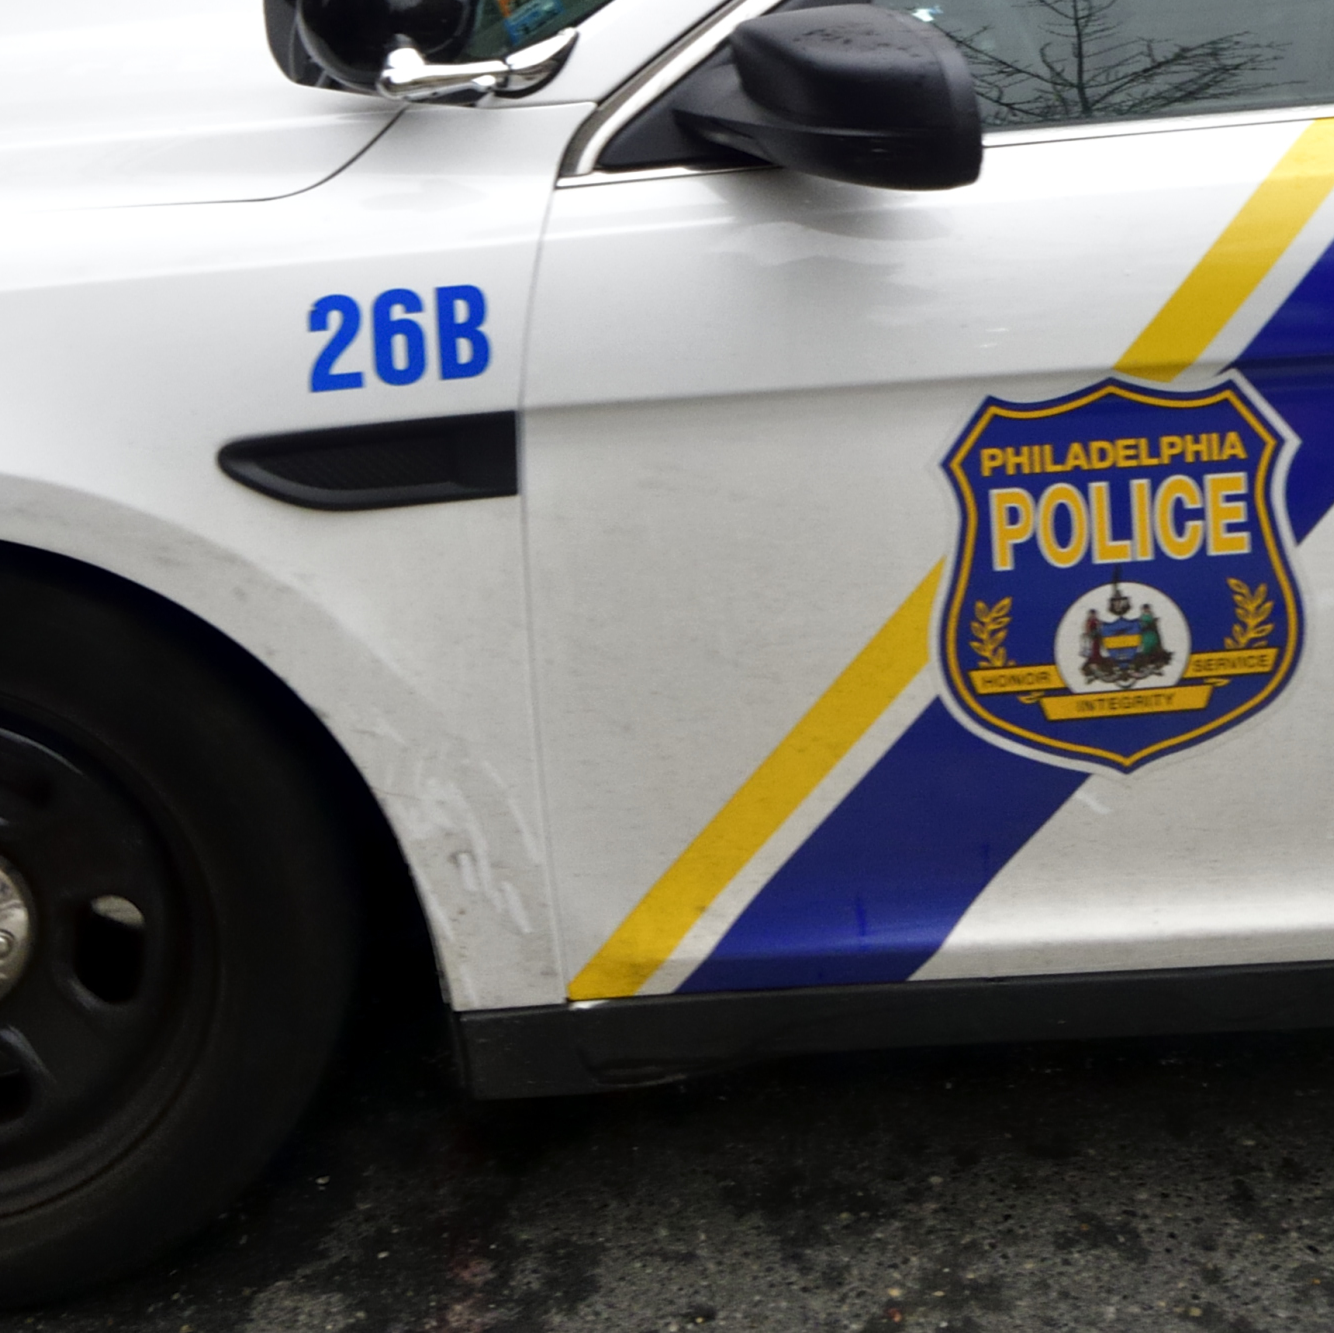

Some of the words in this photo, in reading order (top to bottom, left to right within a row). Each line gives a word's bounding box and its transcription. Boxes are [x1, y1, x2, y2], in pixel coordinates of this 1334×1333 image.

[308, 284, 493, 393] 26B
[980, 431, 1249, 477] PHILADELPHIA
[989, 472, 1251, 571] POLICE
[982, 670, 1051, 687] HONOR
[1192, 654, 1269, 673] SERVICE
[1075, 690, 1176, 713] INTEGRITY
